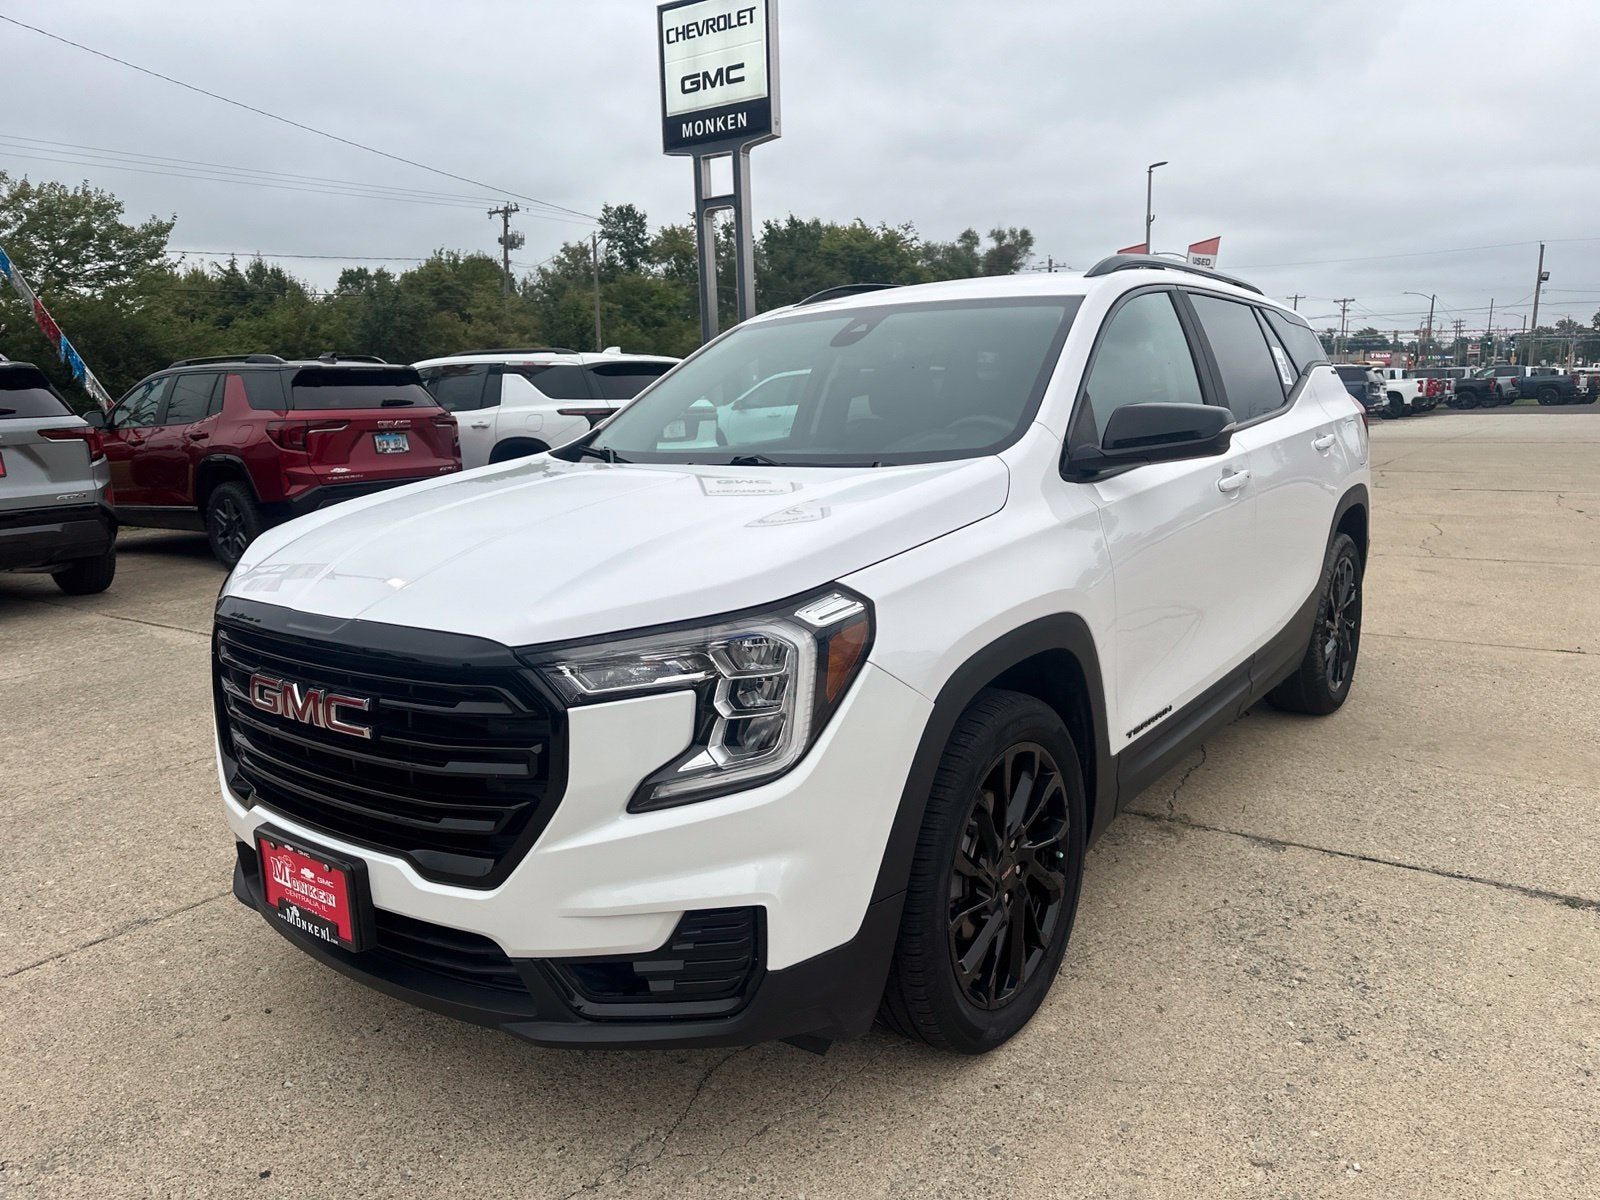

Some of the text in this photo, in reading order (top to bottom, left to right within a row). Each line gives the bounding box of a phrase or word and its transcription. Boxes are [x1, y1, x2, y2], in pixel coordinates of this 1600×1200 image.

[666, 6, 756, 45] CHEVROLET
[680, 62, 745, 95] GMC
[682, 112, 747, 138] MONKEN
[1192, 257, 1211, 266] USED
[249, 673, 373, 740] GMC
[1126, 704, 1173, 739] TERRAIN
[316, 876, 335, 889] GMC
[321, 904, 329, 913] IL
